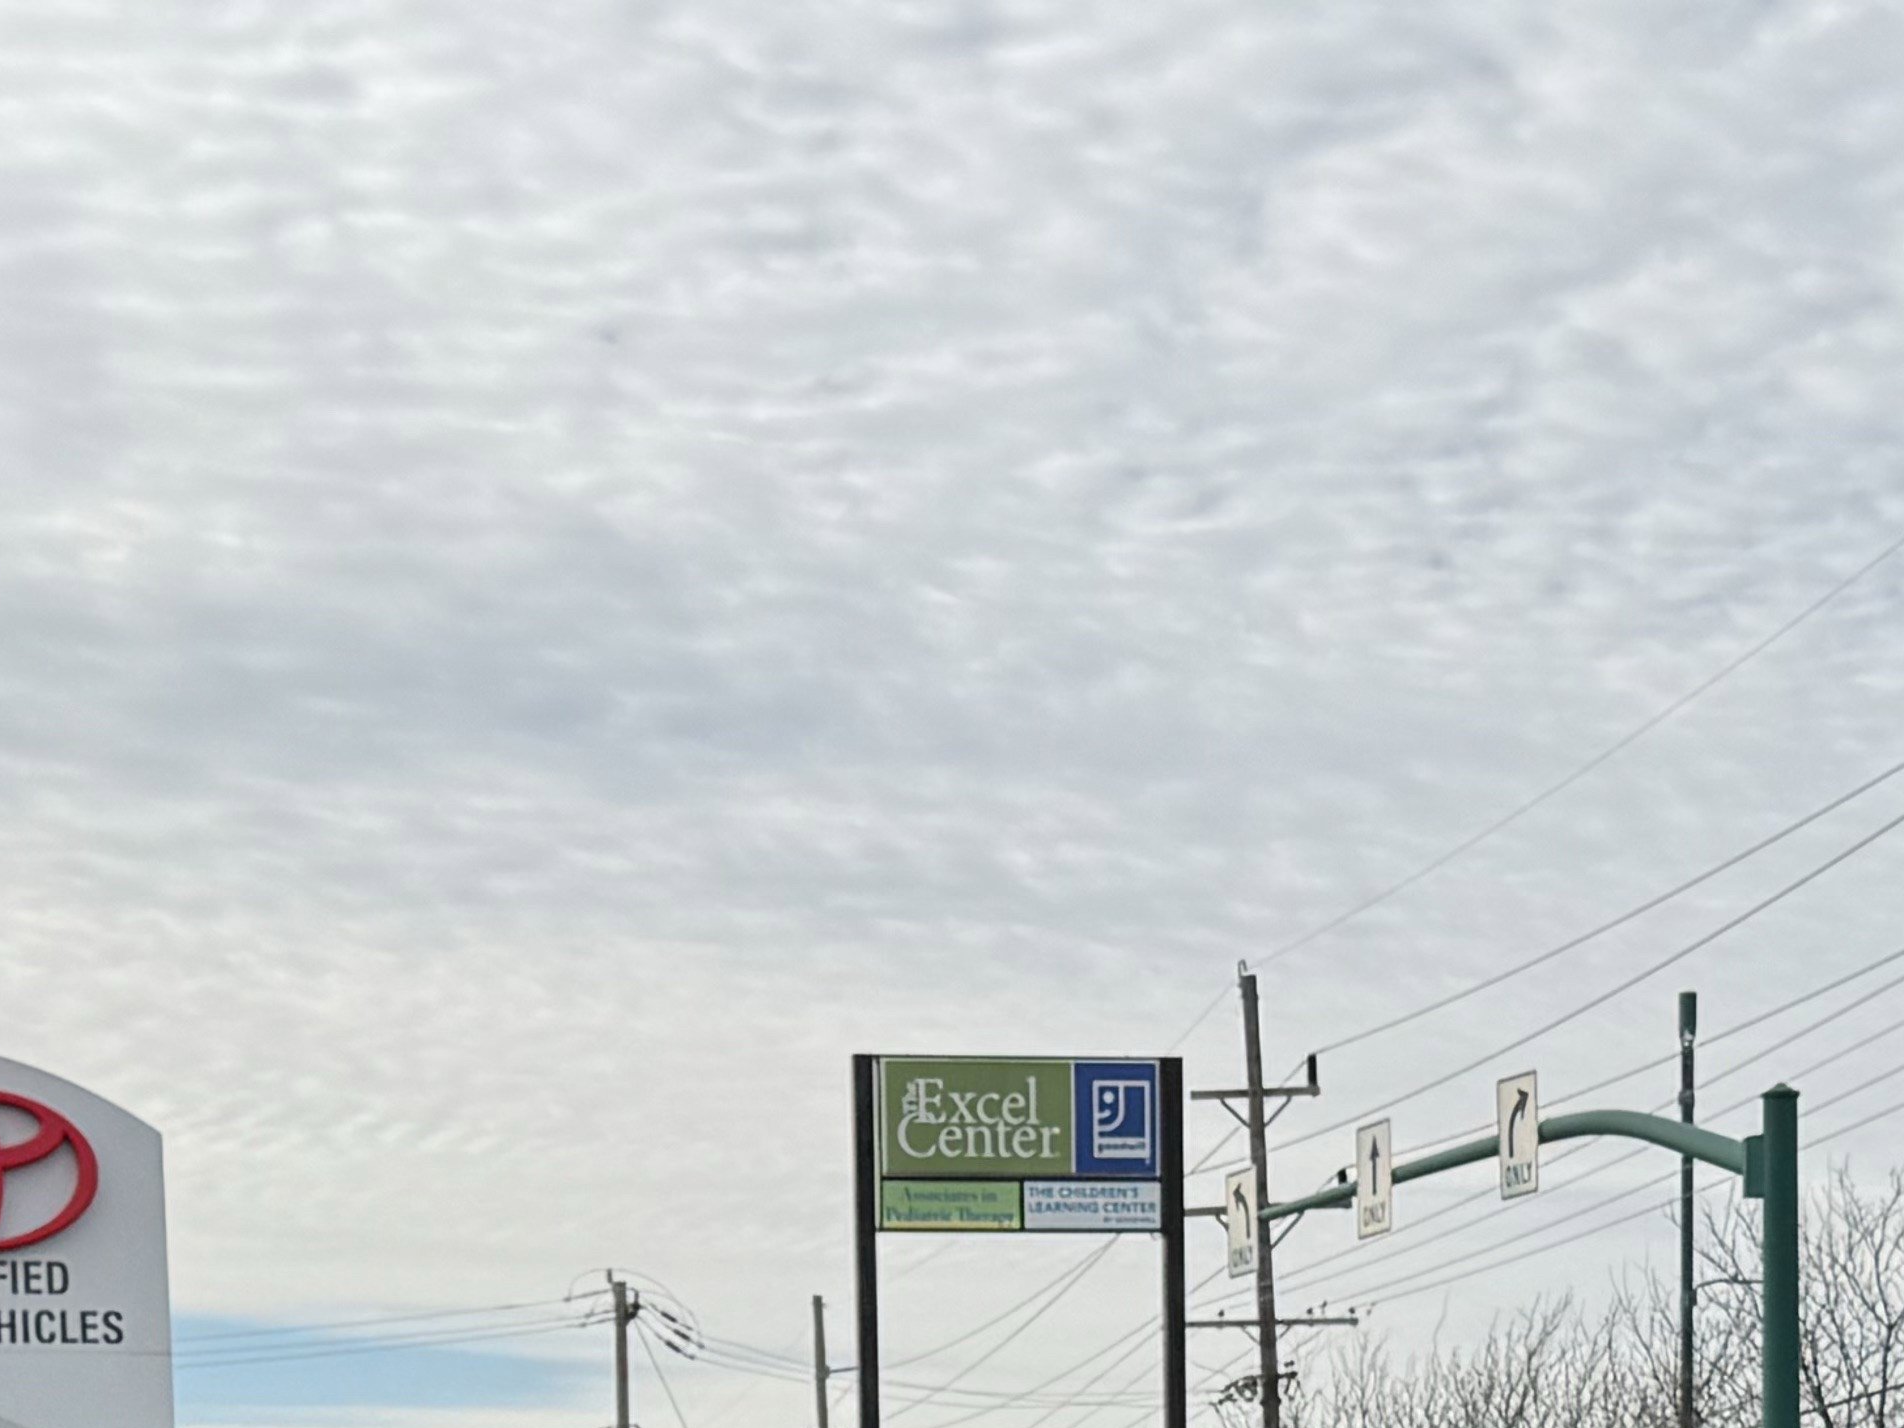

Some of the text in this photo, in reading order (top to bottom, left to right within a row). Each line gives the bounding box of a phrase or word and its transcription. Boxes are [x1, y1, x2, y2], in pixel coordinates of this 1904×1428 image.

[911, 1075, 1041, 1125] Excel
[897, 1110, 1062, 1159] Center
[1506, 1161, 1532, 1188] ONLY
[1028, 1187, 1139, 1199] THE CHILDREN'S
[1027, 1202, 1156, 1214] LEARNING CENTER
